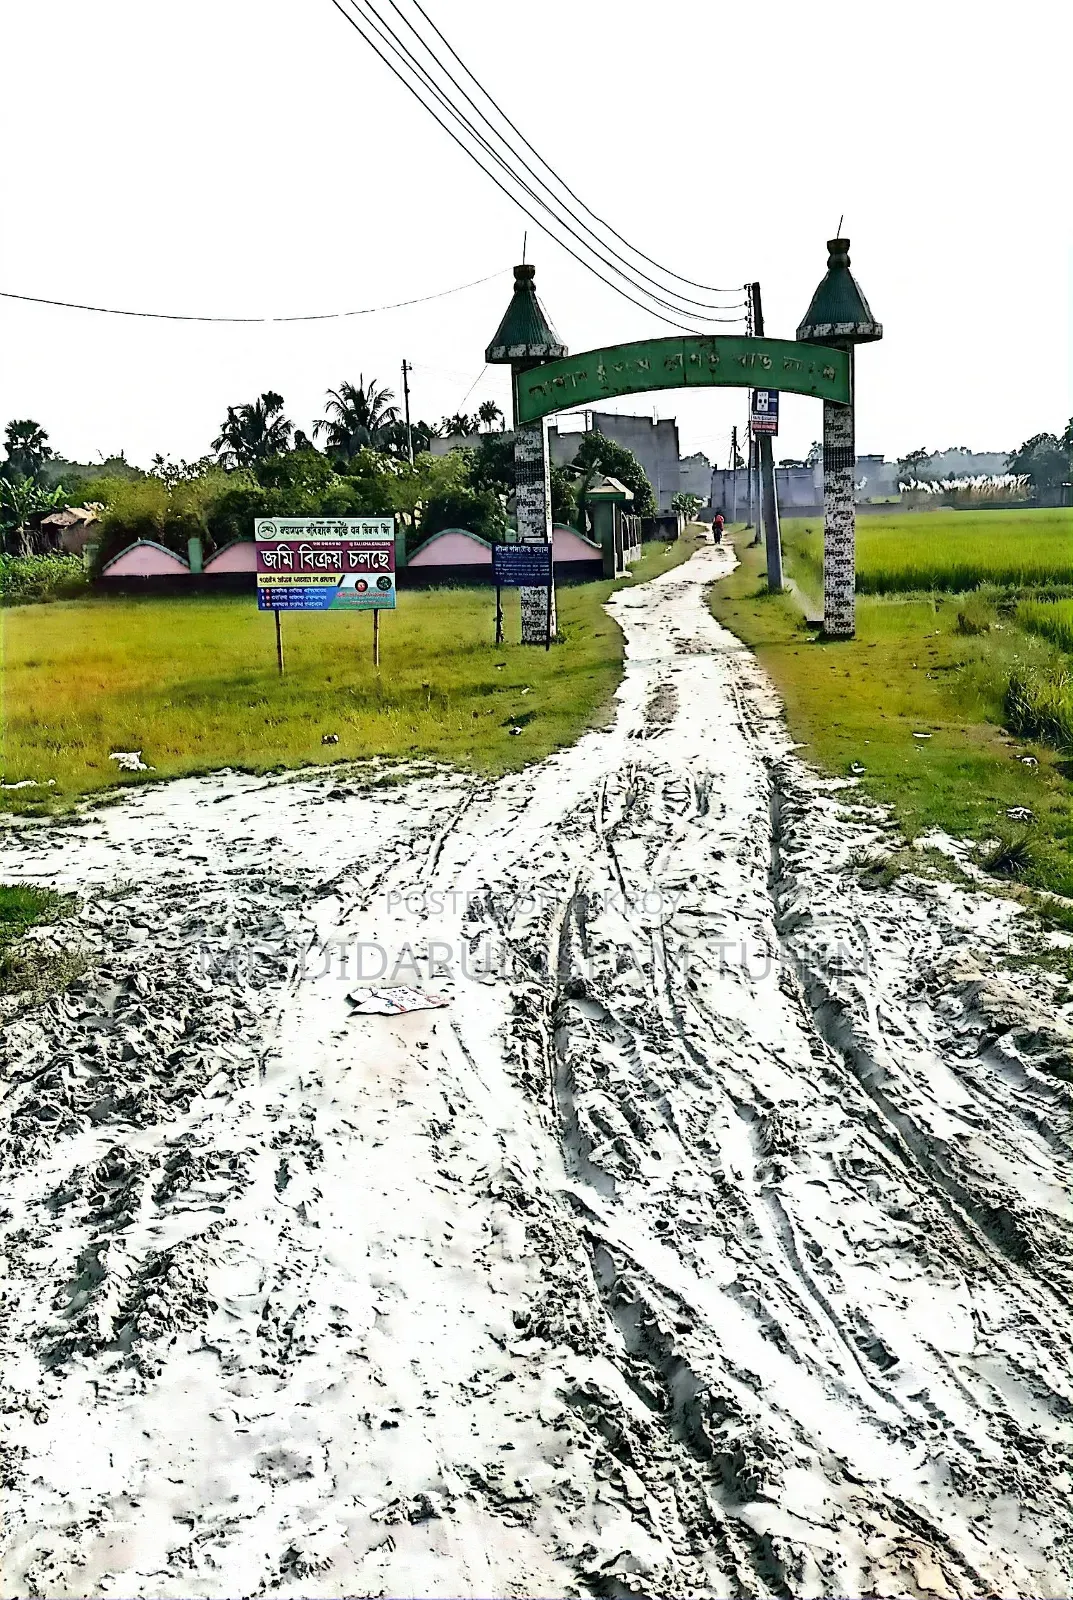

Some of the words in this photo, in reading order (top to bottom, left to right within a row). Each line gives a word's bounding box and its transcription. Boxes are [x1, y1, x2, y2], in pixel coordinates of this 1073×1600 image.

[260, 543, 294, 570] জমি
[298, 543, 343, 570] বিক্রয়
[347, 550, 391, 571] চলছে
